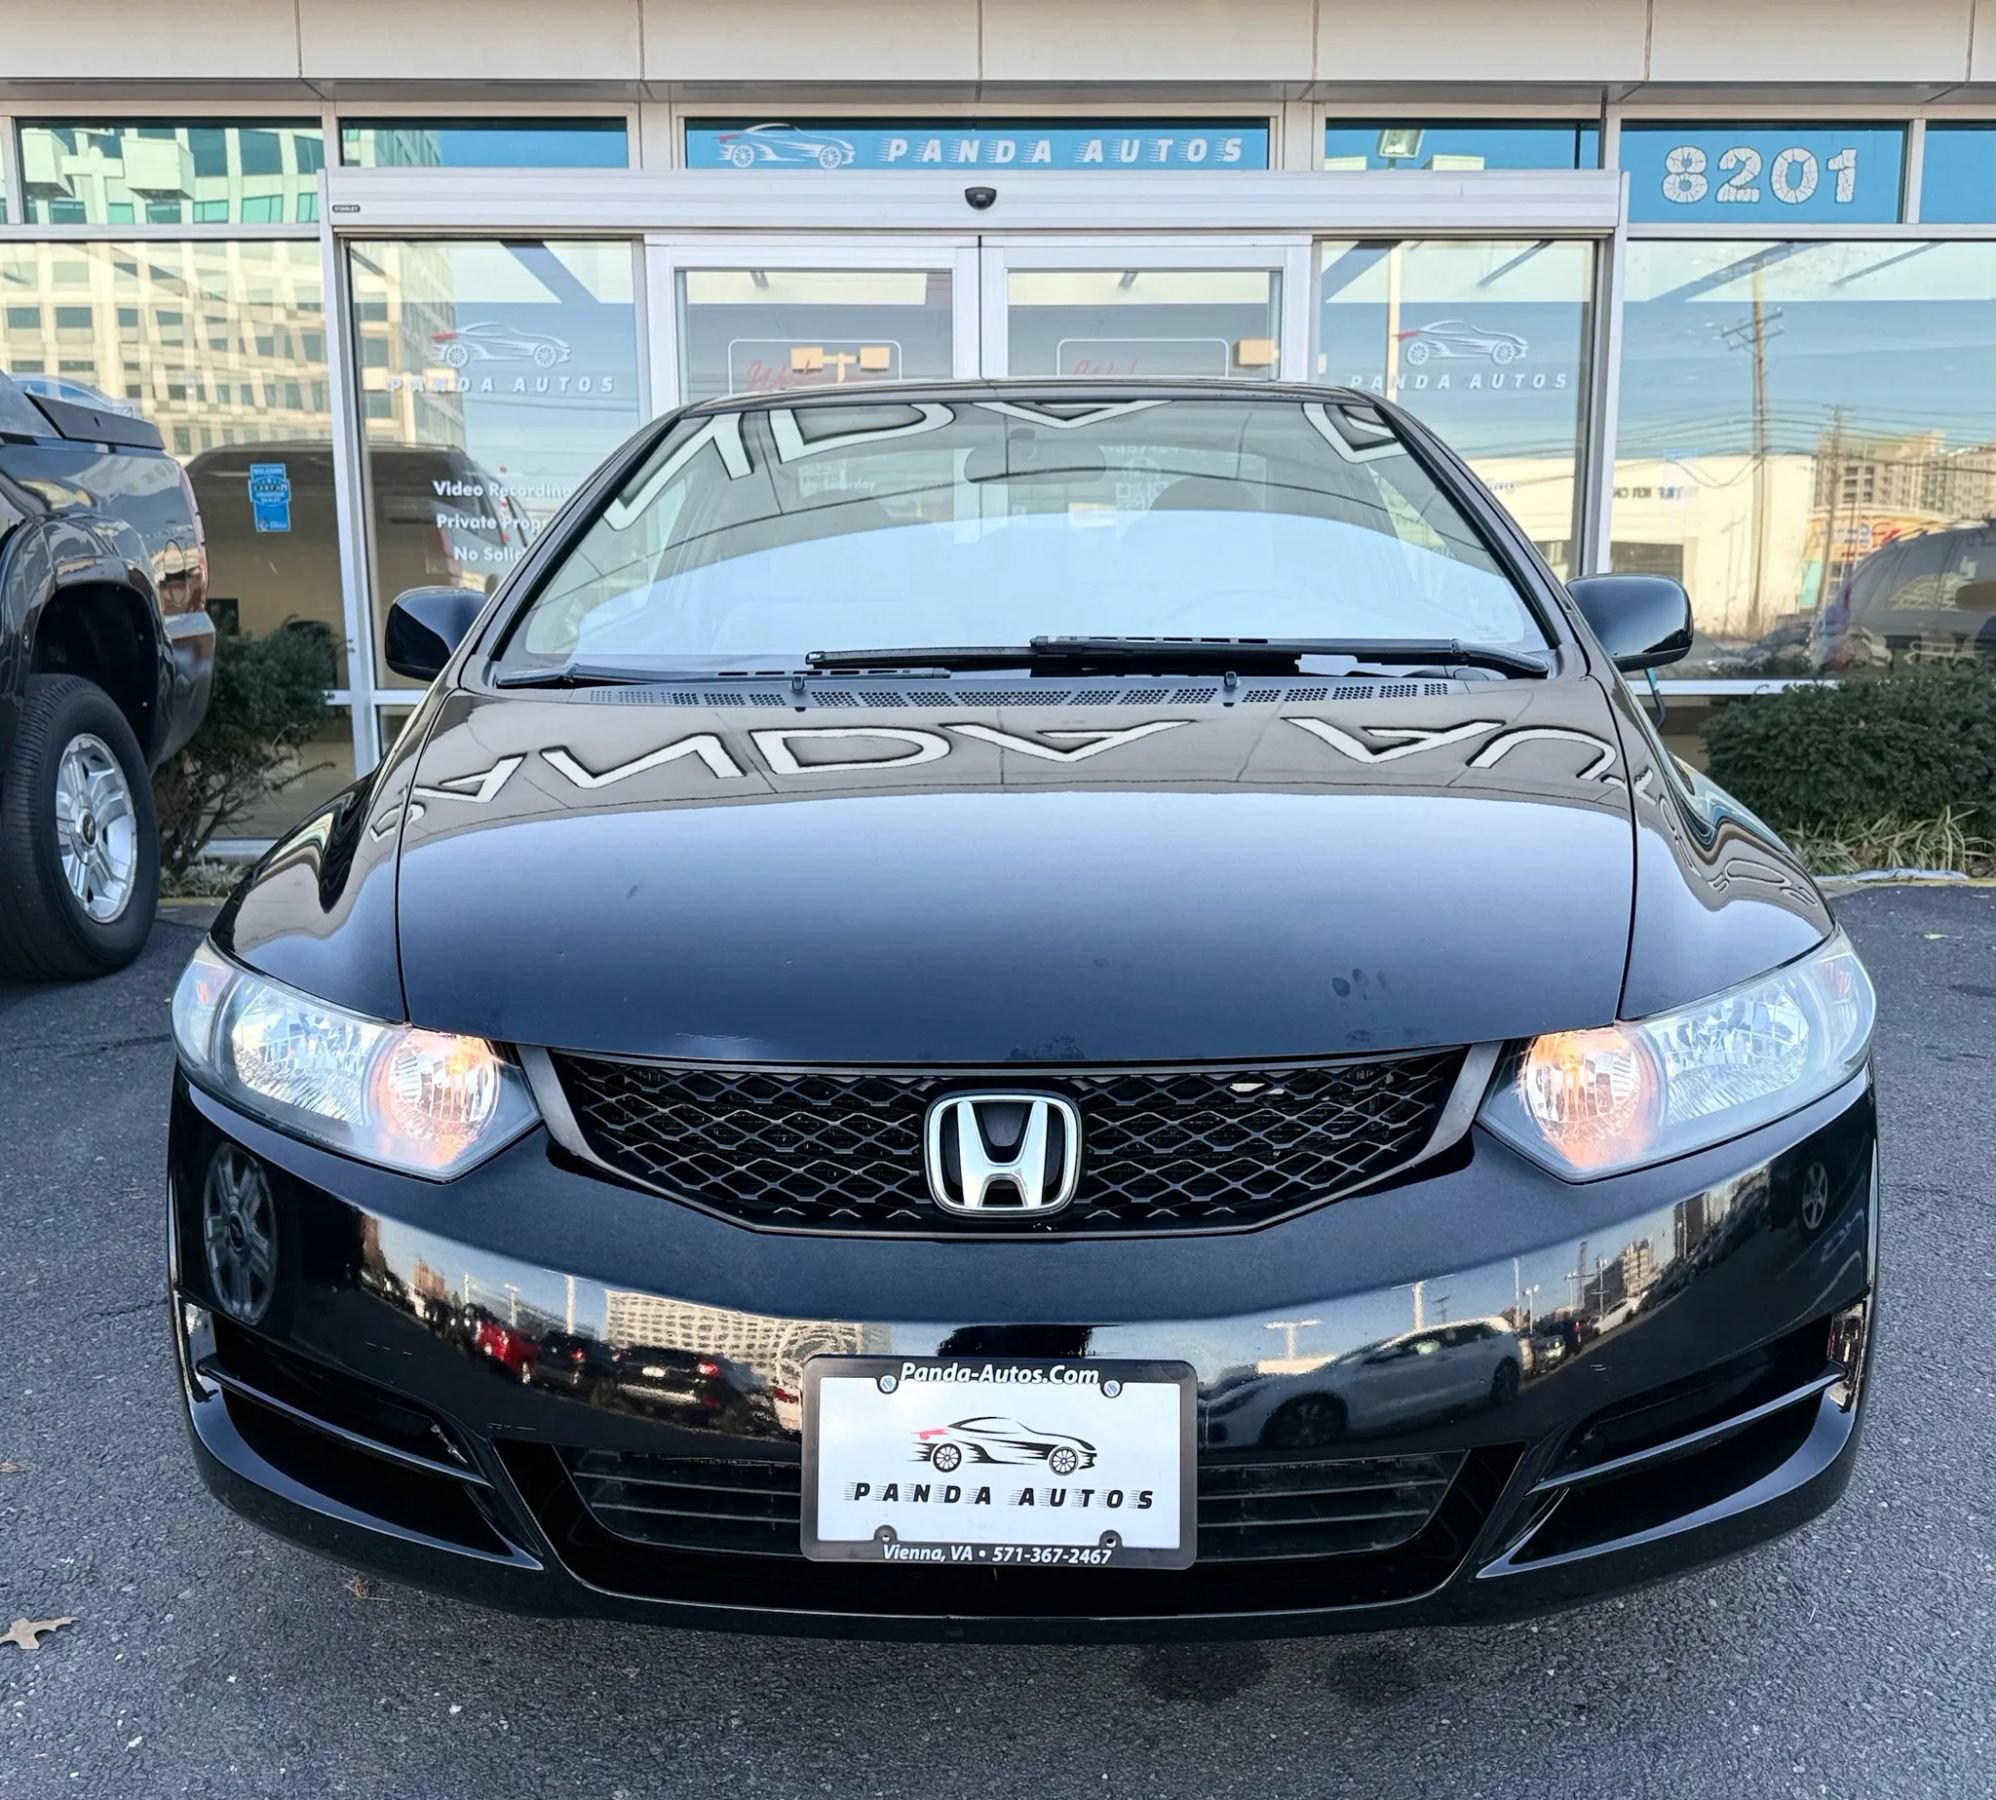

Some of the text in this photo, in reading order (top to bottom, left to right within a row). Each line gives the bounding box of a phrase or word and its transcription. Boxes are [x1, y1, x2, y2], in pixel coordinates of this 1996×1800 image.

[880, 138, 1242, 163] PANDA AUTOS
[1661, 145, 1857, 204] 8201
[388, 375, 616, 393] PANDA AUTOS
[1349, 373, 1569, 390] PANDA AUTOS
[432, 480, 484, 496] Video
[436, 514, 497, 529] Private
[454, 548, 479, 561] No
[900, 1362, 1099, 1384] Panda-Autos.Com
[849, 1482, 1154, 1510] PANDA AUTOS
[882, 1544, 1113, 1565] Vienna, VA 571-367-2467
